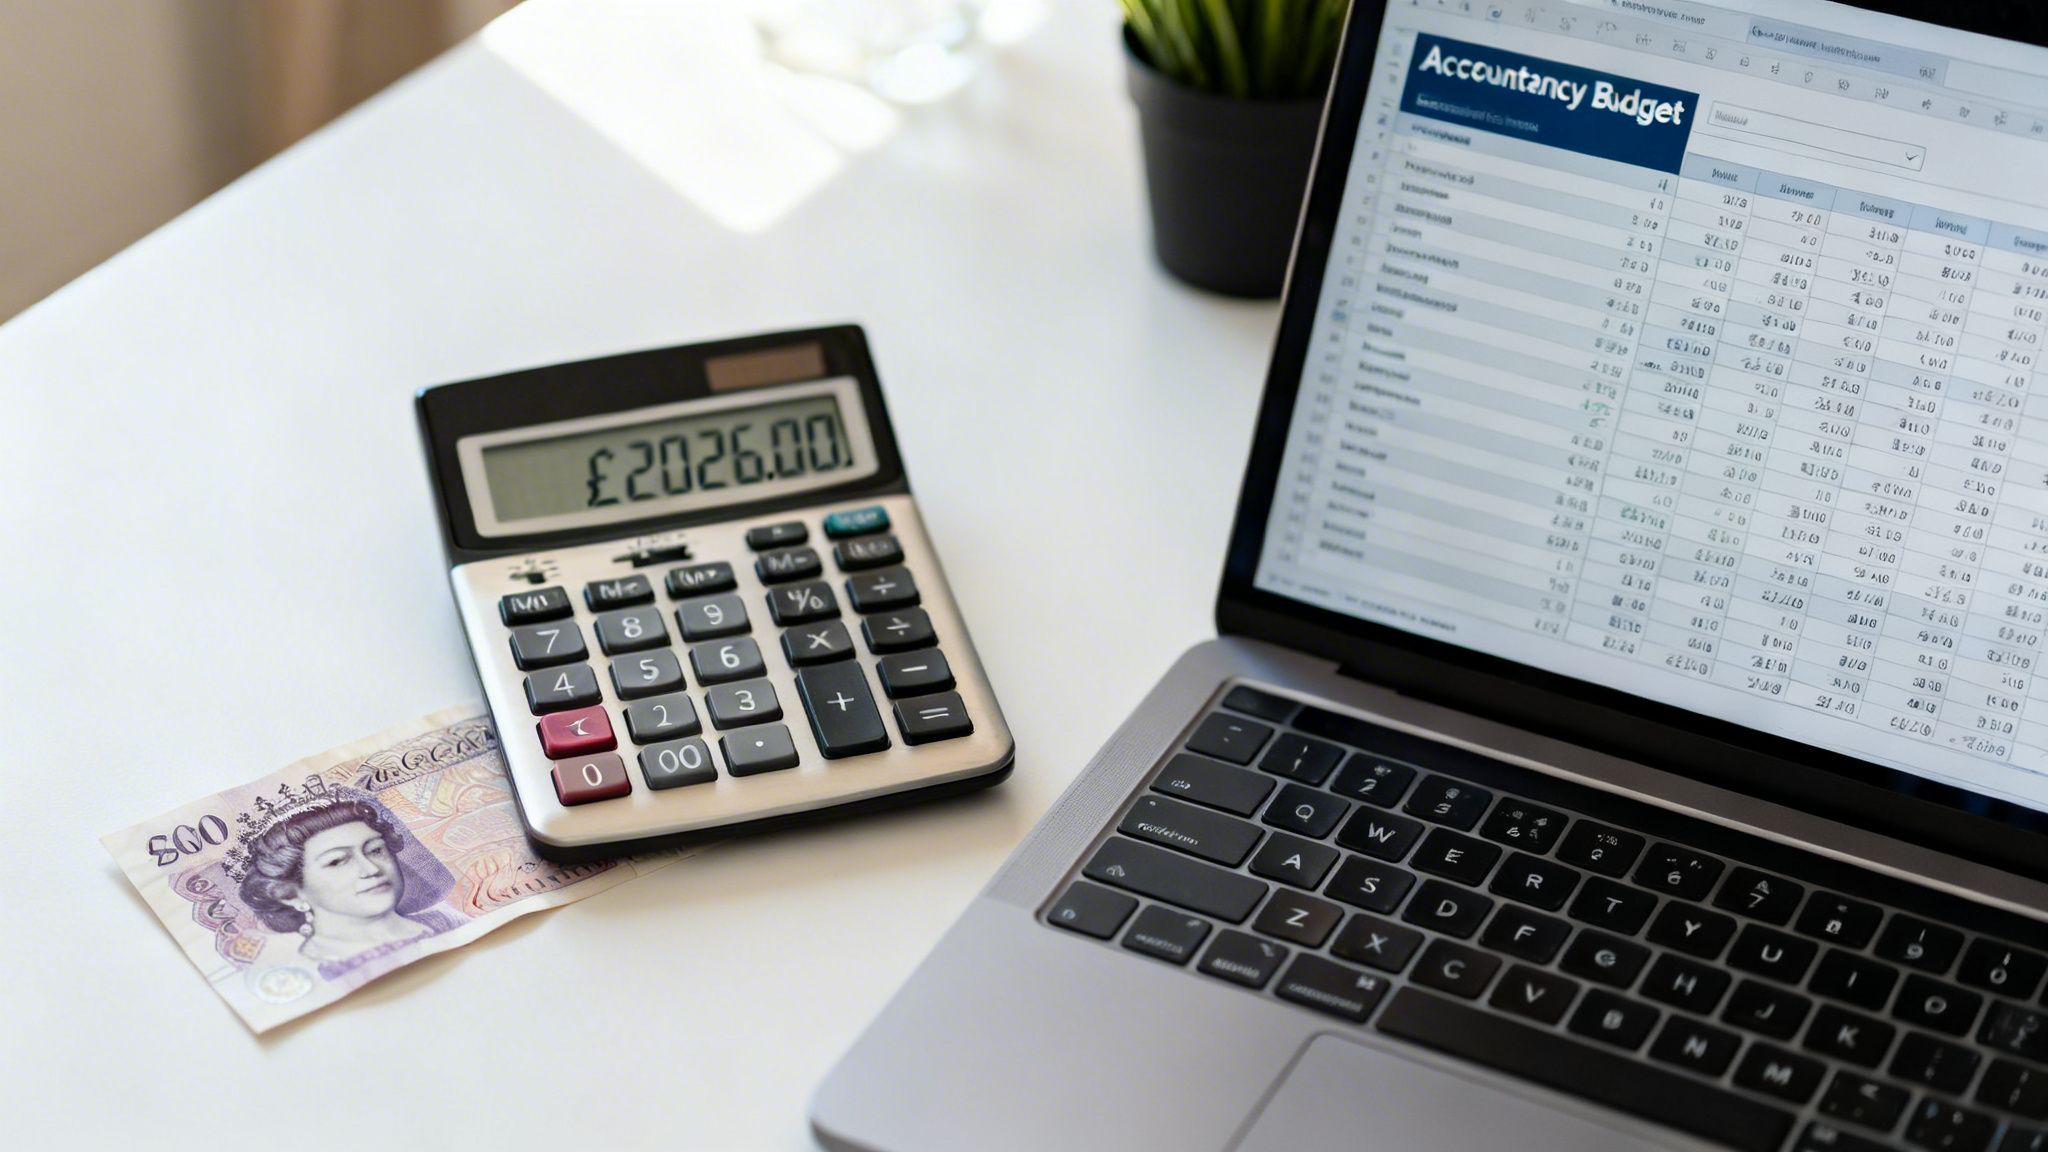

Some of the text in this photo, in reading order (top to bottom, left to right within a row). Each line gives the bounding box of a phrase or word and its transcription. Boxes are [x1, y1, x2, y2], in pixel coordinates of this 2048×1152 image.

[1418, 45, 1588, 110] Accountancy
[1591, 81, 1685, 126] Budget
[704, 604, 723, 625] 9
[622, 618, 642, 637] 8
[537, 630, 562, 655] 7
[721, 646, 739, 668] 6
[640, 659, 659, 682] 5
[553, 672, 574, 695] 4
[736, 690, 755, 710] 3
[653, 705, 672, 727] 2
[659, 744, 703, 774] 00
[582, 764, 602, 786] 0
[1369, 823, 1395, 842] W
[1282, 854, 1300, 869] A
[1445, 849, 1464, 863] E
[1361, 878, 1379, 892] S
[1526, 874, 1543, 888] R
[1437, 900, 1457, 916] D
[1607, 897, 1622, 912] T
[1287, 909, 1308, 926] Z
[1515, 926, 1535, 940] F
[1686, 921, 1700, 936] Y
[1366, 934, 1386, 952] X
[1762, 946, 1782, 961] U
[1444, 961, 1464, 978] C
[1527, 984, 1544, 1002] V
[1674, 975, 1696, 993] H
[1757, 1005, 1774, 1018] J
[1838, 1026, 1856, 1045] K
[1685, 1037, 1706, 1057] N
[1765, 1065, 1792, 1084] M
